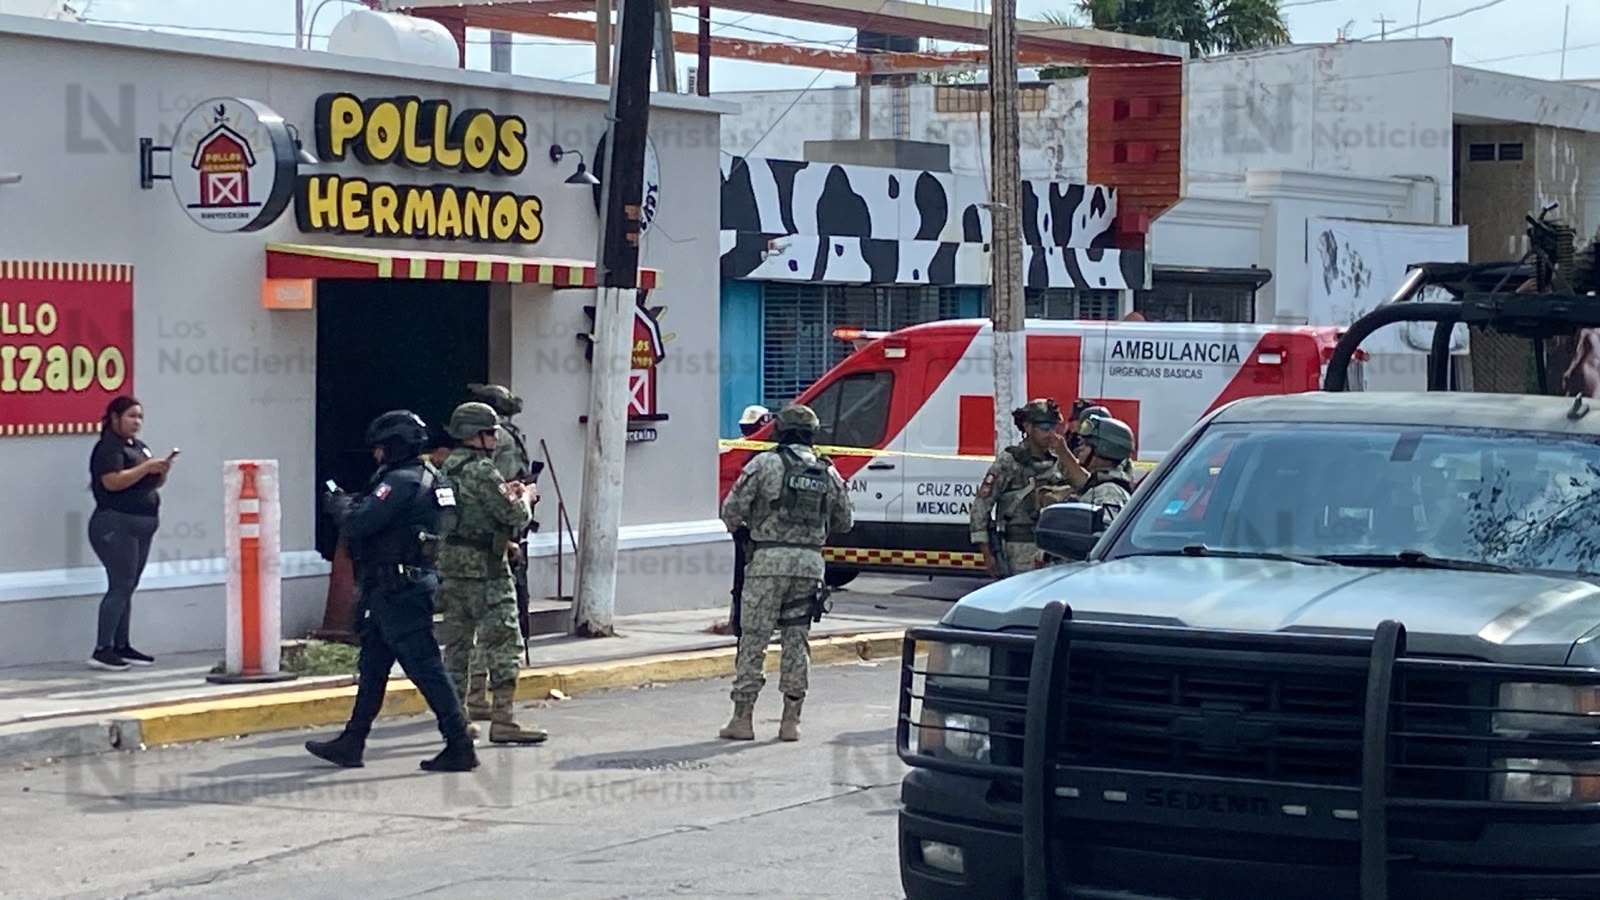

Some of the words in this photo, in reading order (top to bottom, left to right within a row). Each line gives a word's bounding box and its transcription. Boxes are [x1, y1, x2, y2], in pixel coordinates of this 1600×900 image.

[330, 96, 526, 171] POLLOS
[308, 177, 541, 241] HERMANOS
[1, 302, 58, 335] LLO
[1111, 340, 1241, 362] AMBULANCIA
[1110, 366, 1161, 378] URGENCIAS
[1163, 367, 1203, 379] BASICAS
[847, 480, 867, 492] AN
[916, 483, 949, 497] CRUZ
